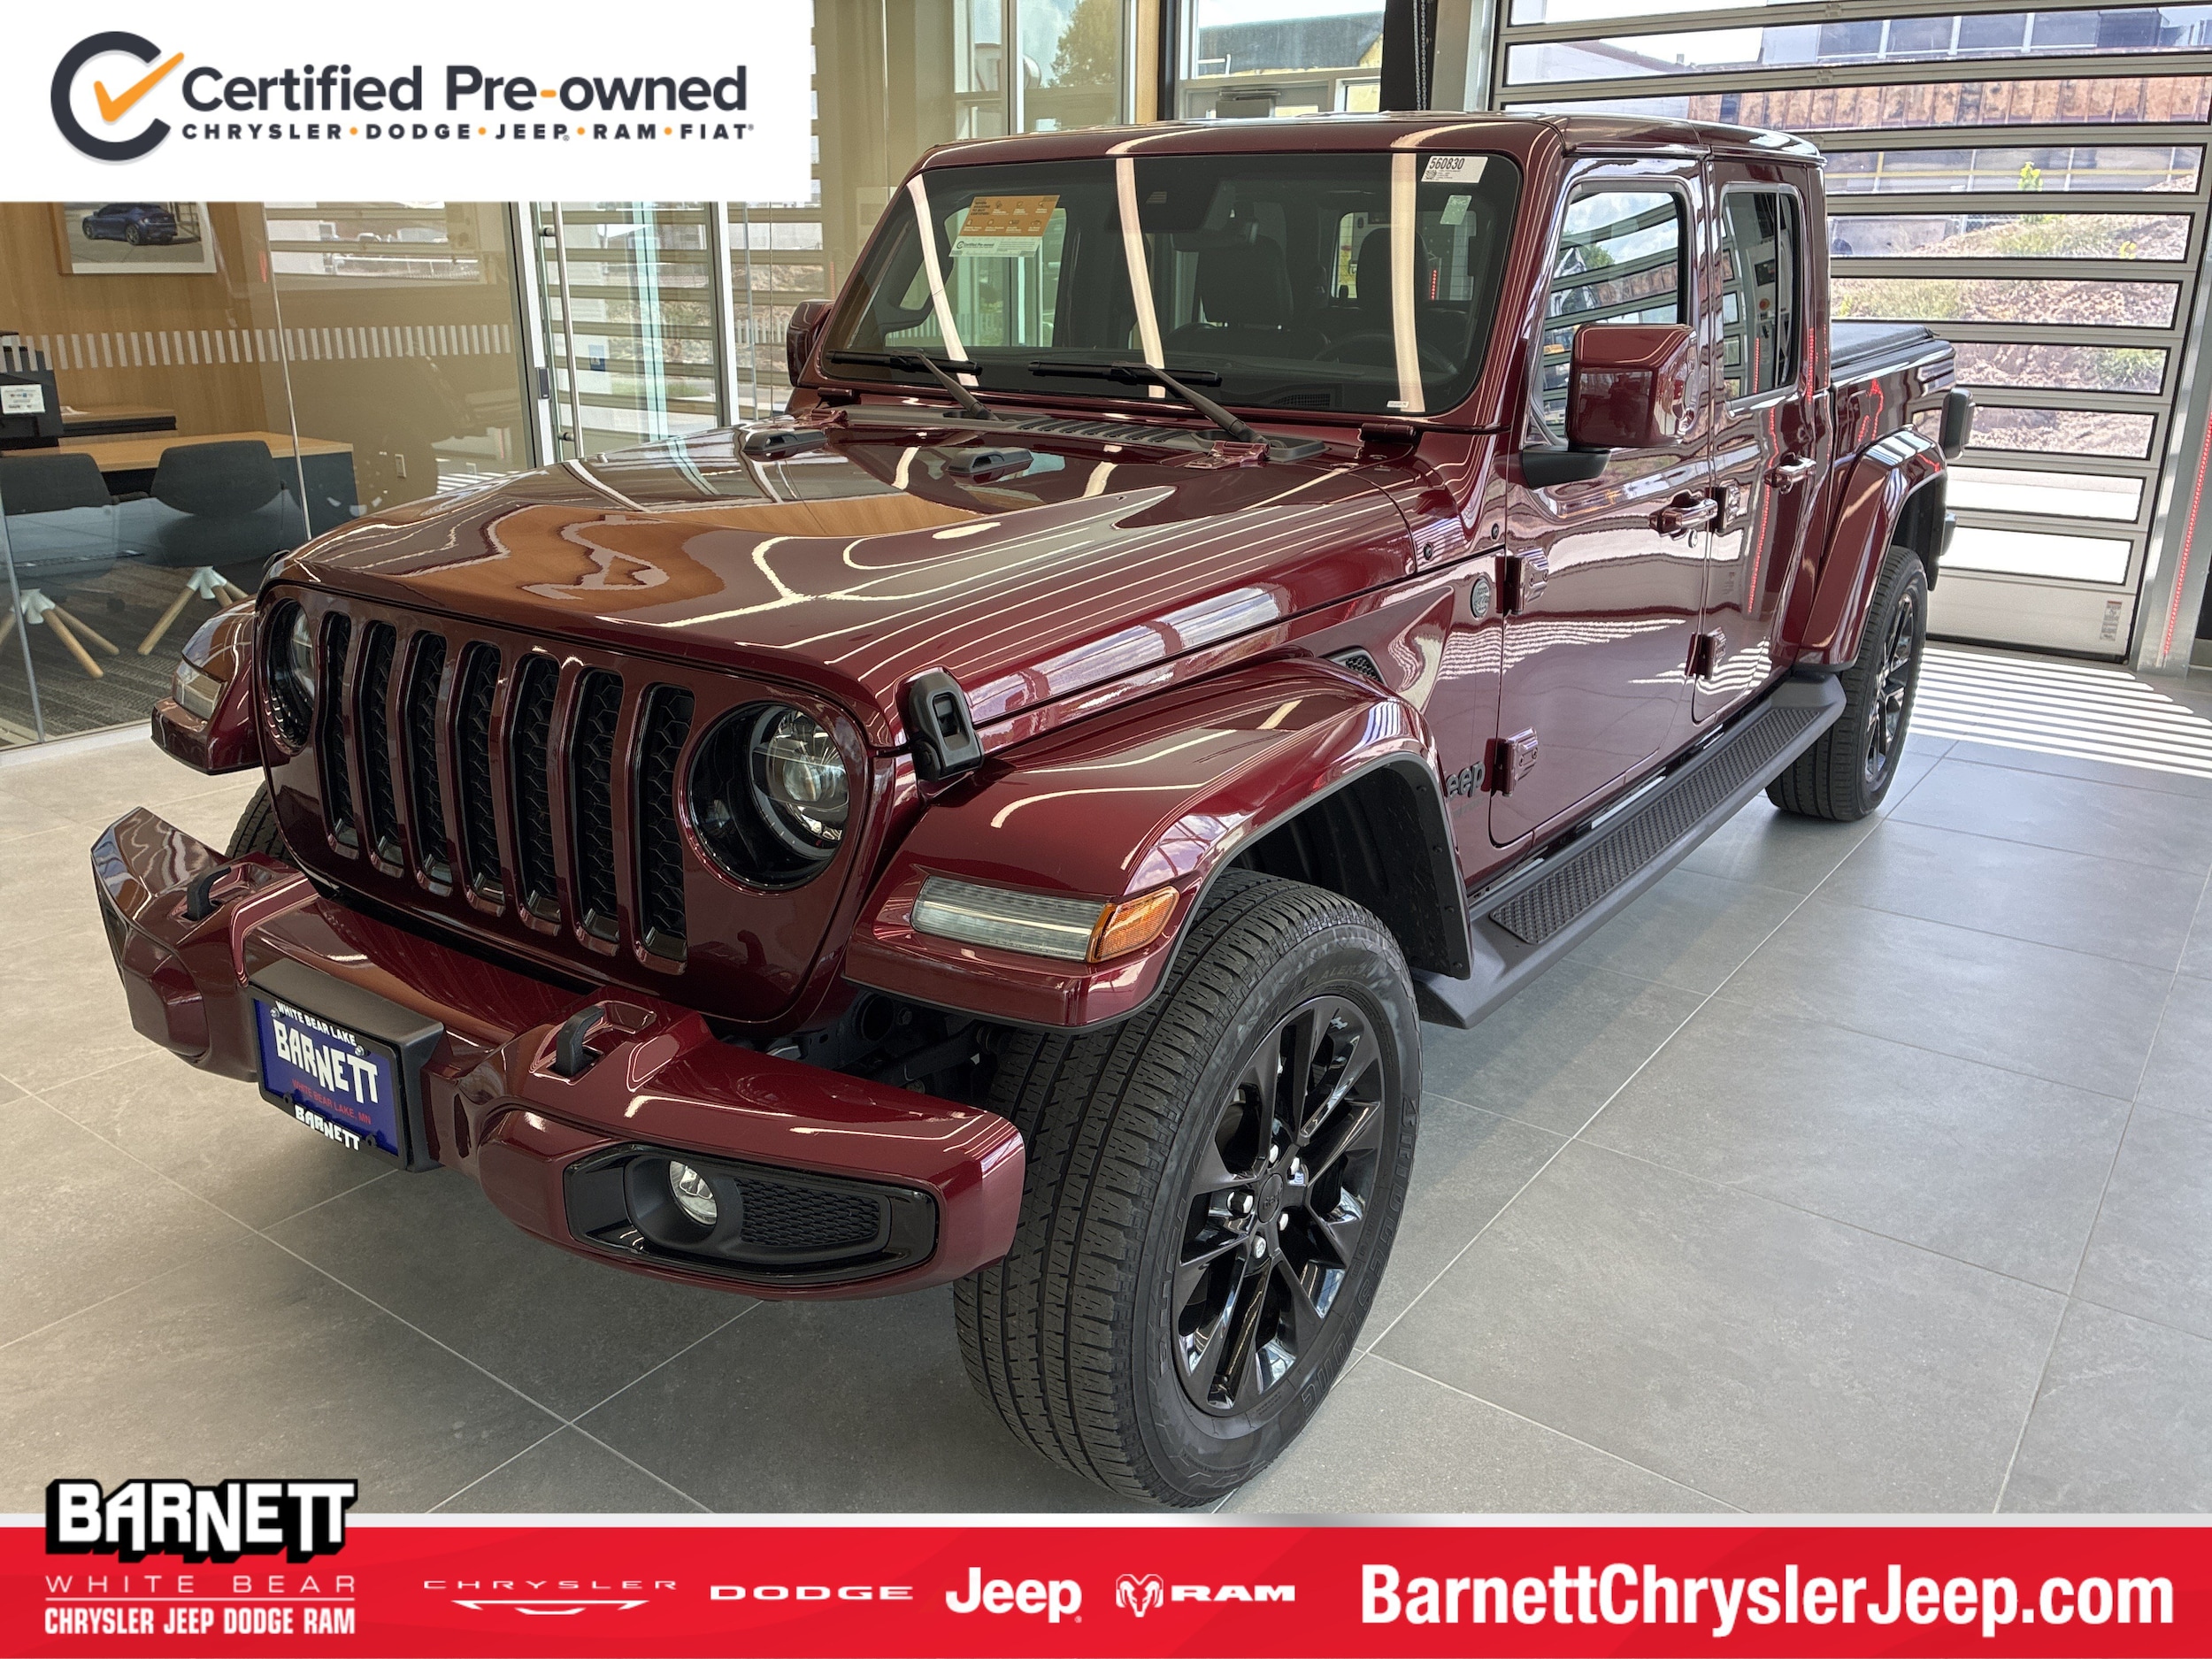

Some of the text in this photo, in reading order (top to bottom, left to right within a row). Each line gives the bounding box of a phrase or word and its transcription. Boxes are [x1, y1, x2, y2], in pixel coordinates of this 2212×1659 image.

[1429, 157, 1465, 170] 560830
[1446, 761, 1486, 801] eep
[275, 1001, 357, 1047] WHITE BEAR LAKE
[273, 1018, 379, 1103] BARNETT
[291, 1079, 312, 1098] WHITE
[313, 1090, 333, 1110] BEAR
[358, 1111, 373, 1125] MN
[294, 1104, 360, 1151] BARNETT
[1301, 1095, 1421, 1415] BRIDGESTONE
